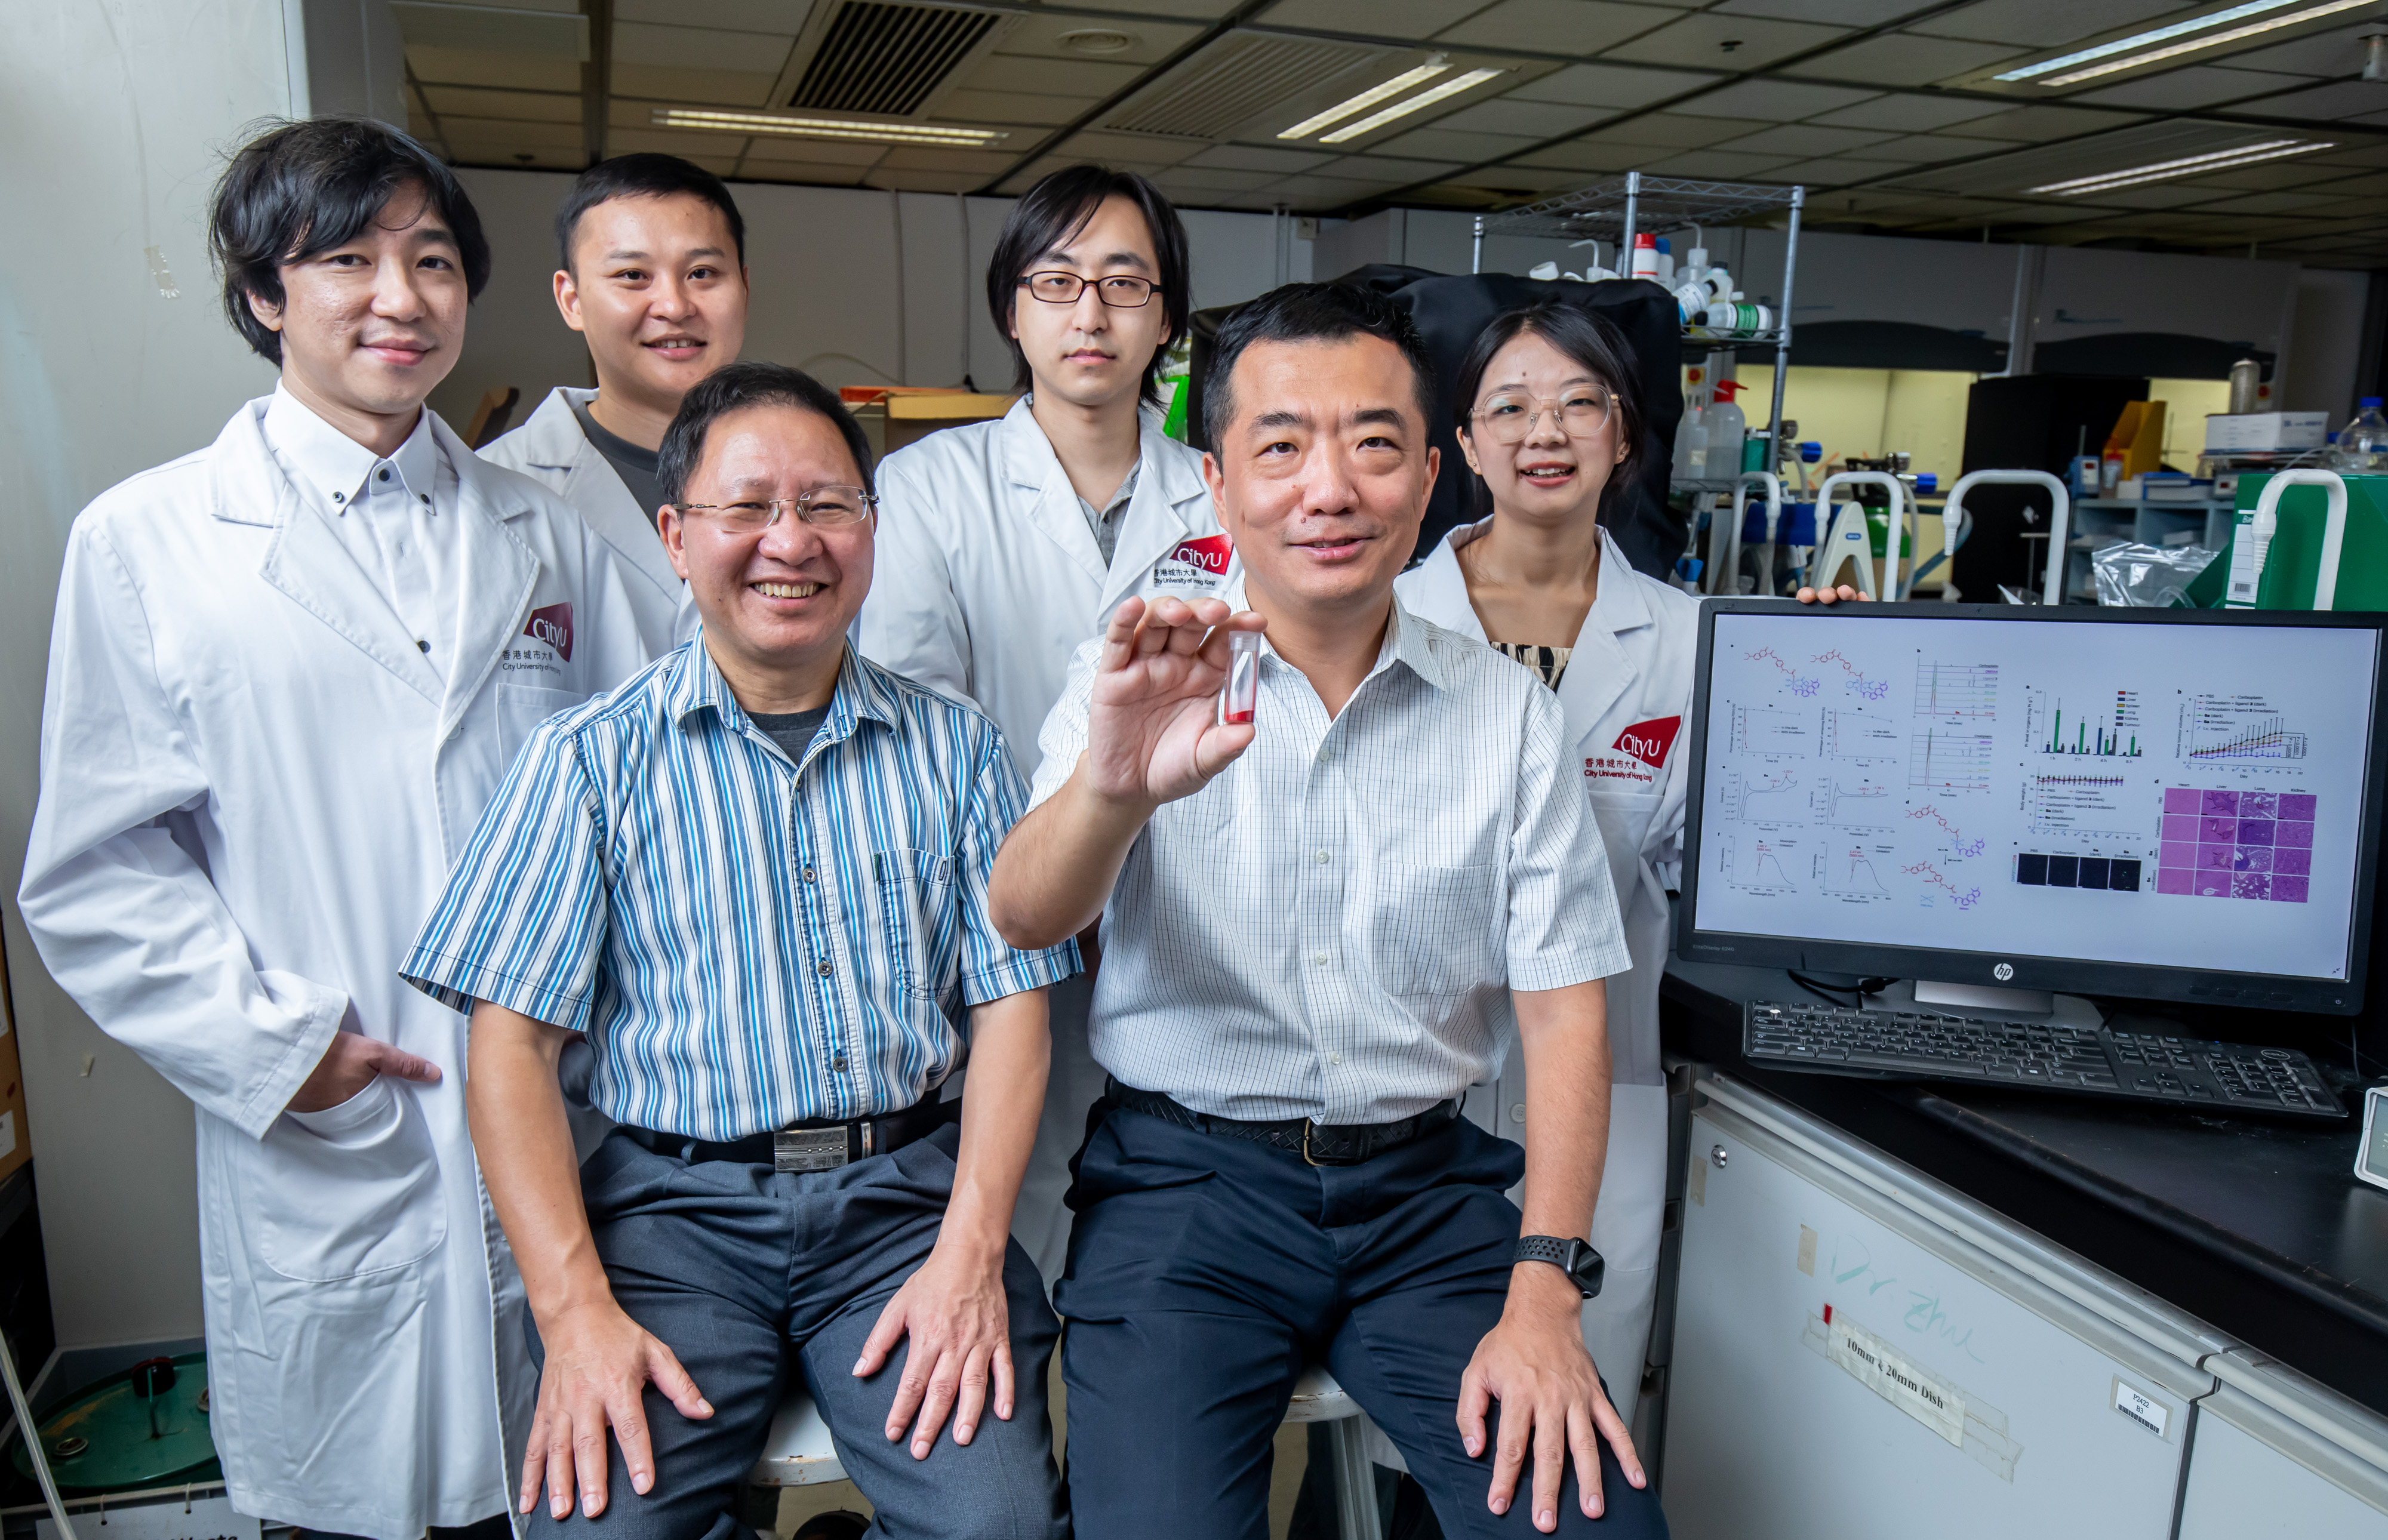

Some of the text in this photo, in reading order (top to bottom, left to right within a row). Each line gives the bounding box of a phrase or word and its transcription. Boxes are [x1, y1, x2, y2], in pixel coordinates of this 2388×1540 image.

[1177, 548, 1222, 569] CityU
[503, 663, 516, 671] City
[516, 663, 544, 672] University
[1621, 734, 1660, 760] CityU
[1584, 770, 1598, 778] City
[1996, 963, 2012, 981] hp
[1847, 1338, 1875, 1365] 10mm
[1887, 1365, 1917, 1393] 20mm
[1921, 1385, 1943, 1410] Dish
[2133, 1393, 2150, 1408] P2422
[2136, 1405, 2144, 1414] B3
